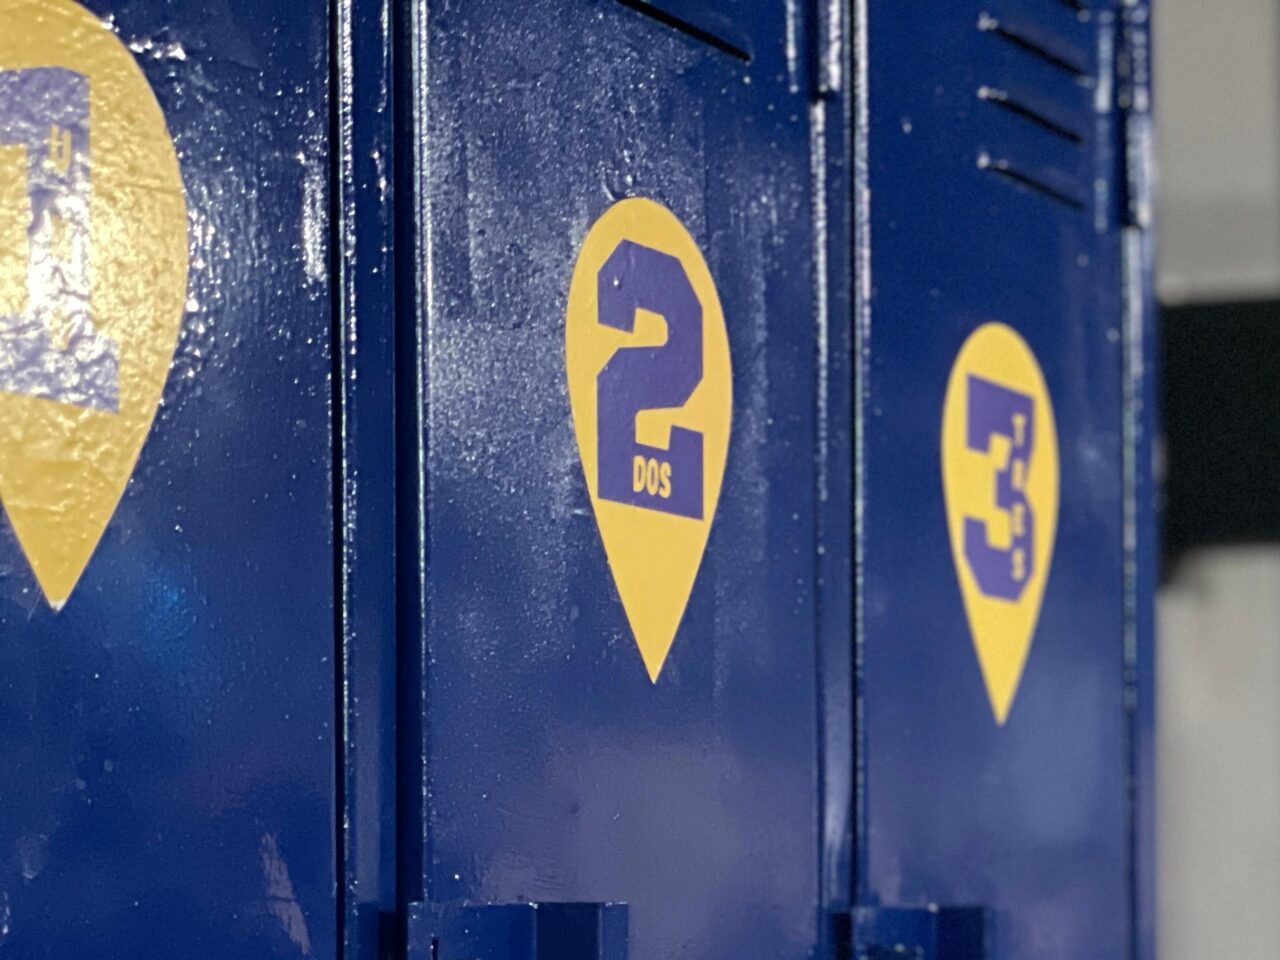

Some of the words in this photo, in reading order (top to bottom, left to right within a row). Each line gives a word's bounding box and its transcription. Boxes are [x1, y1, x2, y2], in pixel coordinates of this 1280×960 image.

[597, 238, 704, 521] 2
[633, 455, 672, 499] DOS
[963, 372, 1035, 604] 3
